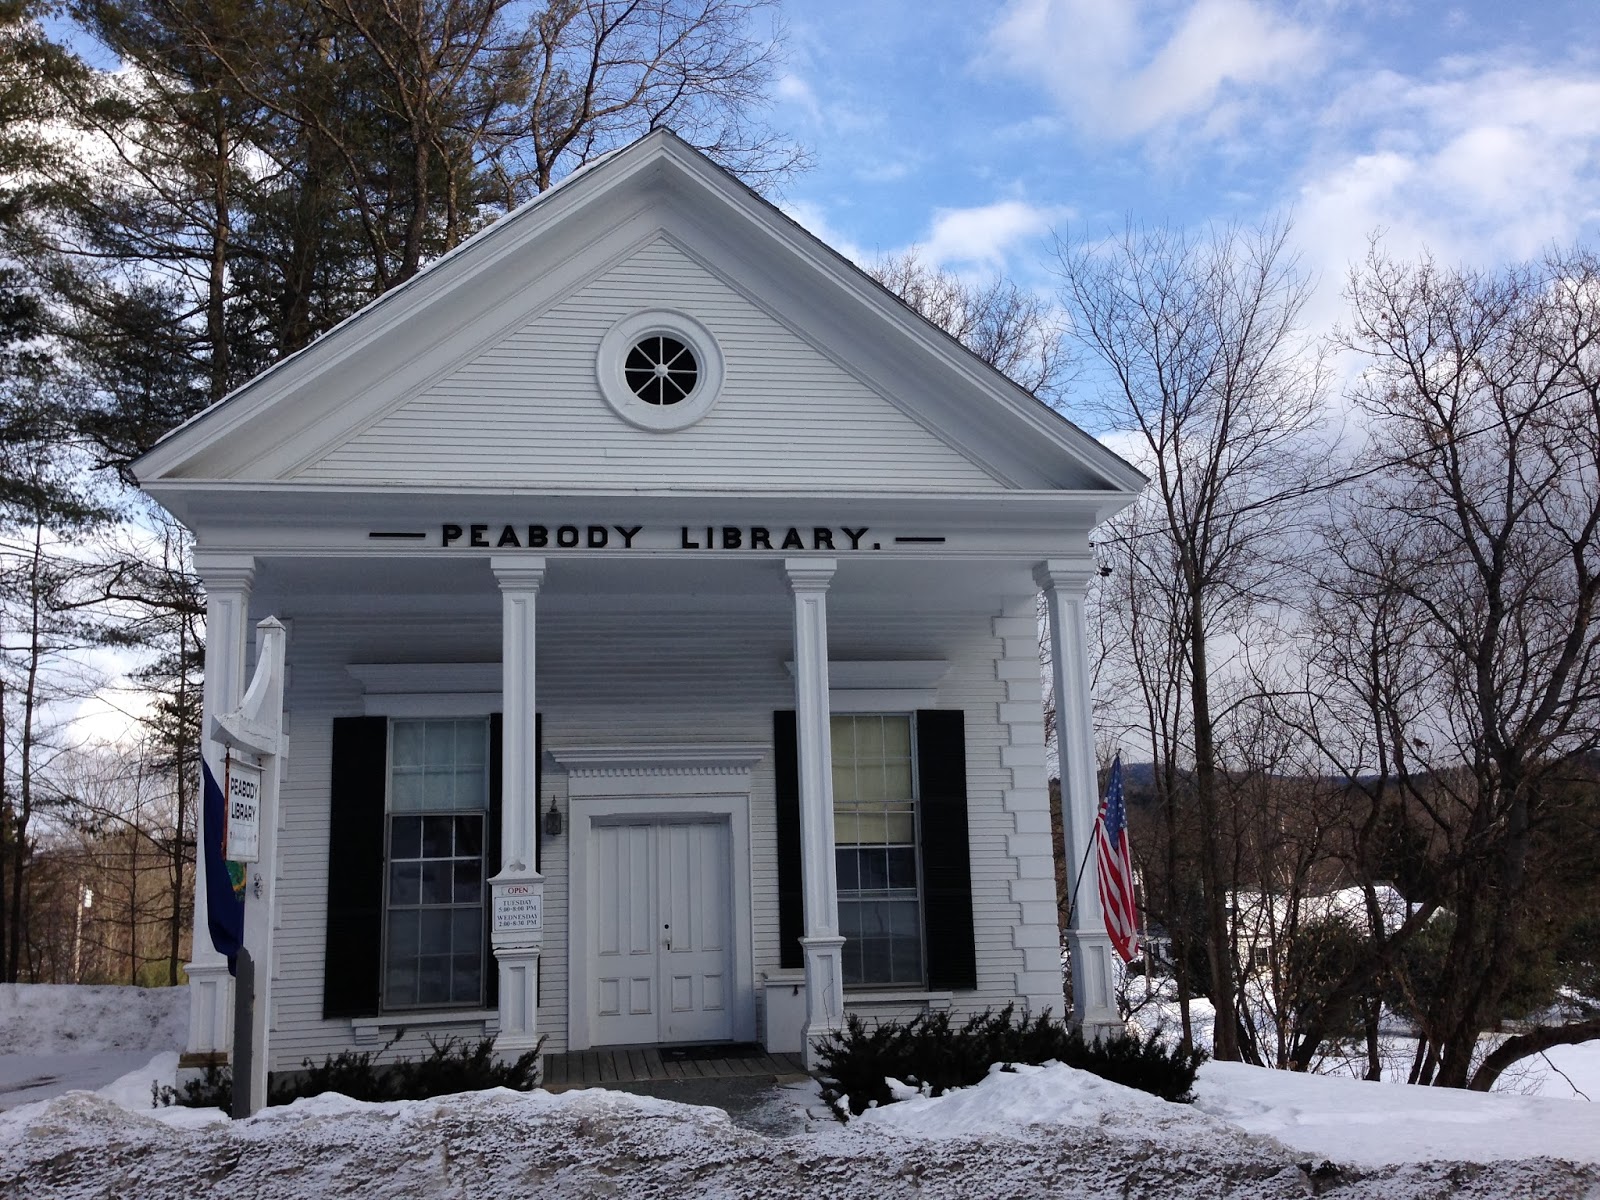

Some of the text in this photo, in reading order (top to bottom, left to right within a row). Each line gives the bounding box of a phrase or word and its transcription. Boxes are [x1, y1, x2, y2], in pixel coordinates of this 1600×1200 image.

[442, 524, 643, 549] PEABODY
[230, 777, 258, 800] PEABODY
[231, 801, 256, 822] LIBRARY
[507, 887, 528, 895] OPEN
